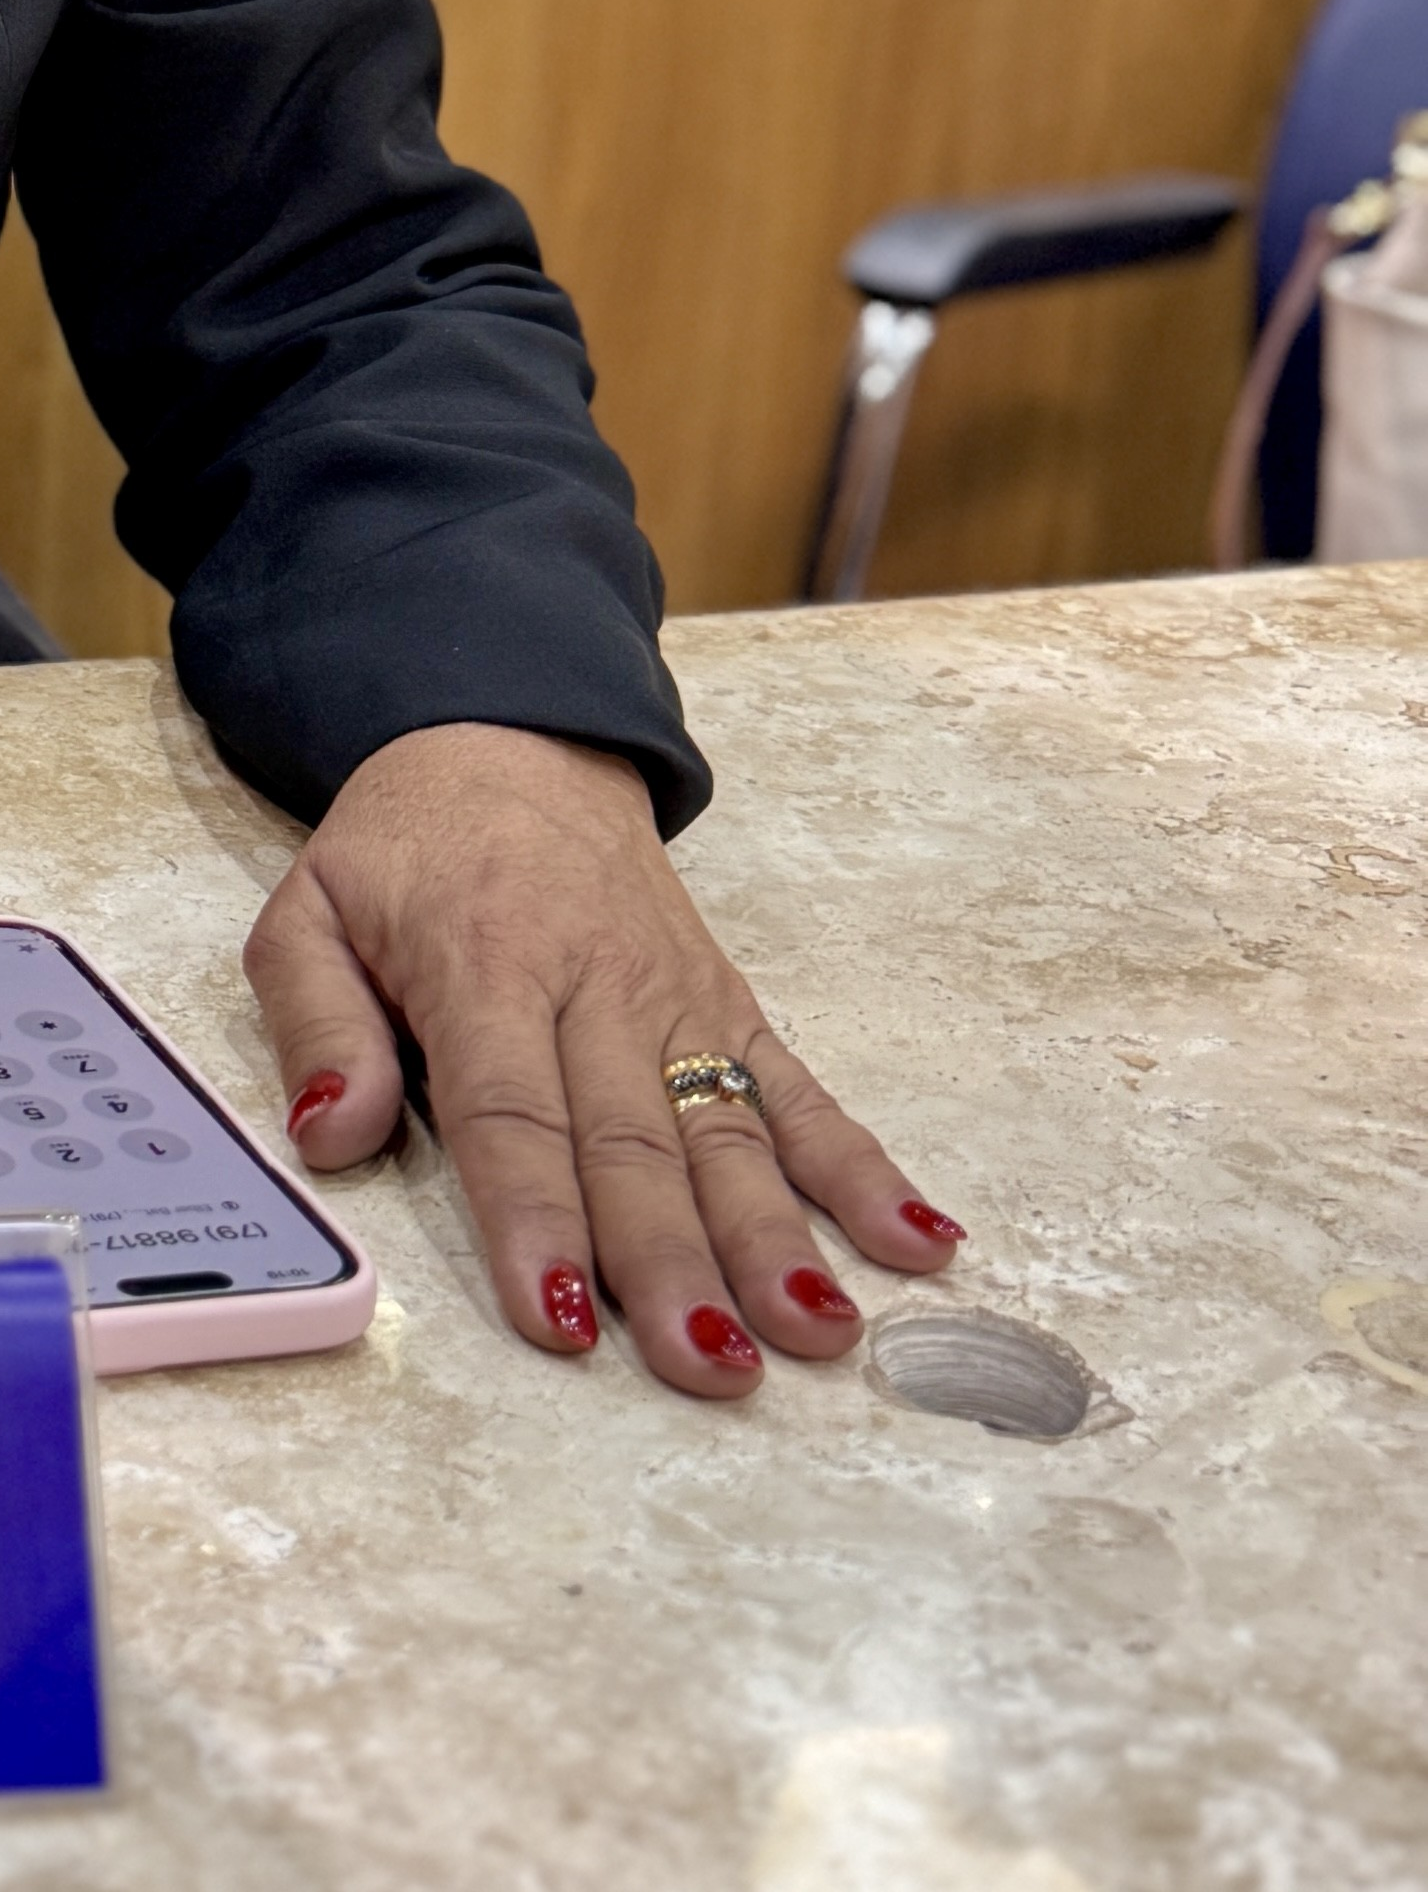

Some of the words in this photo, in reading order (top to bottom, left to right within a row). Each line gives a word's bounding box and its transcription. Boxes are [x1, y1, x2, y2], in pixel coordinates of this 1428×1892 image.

[79, 1061, 97, 1073] 7
[23, 1107, 45, 1120] 5
[107, 1101, 128, 1113] 4
[147, 1142, 166, 1155] 1
[56, 1149, 80, 1162] 2
[205, 1222, 268, 1242] (79)
[72, 1228, 200, 1254] 98817-
